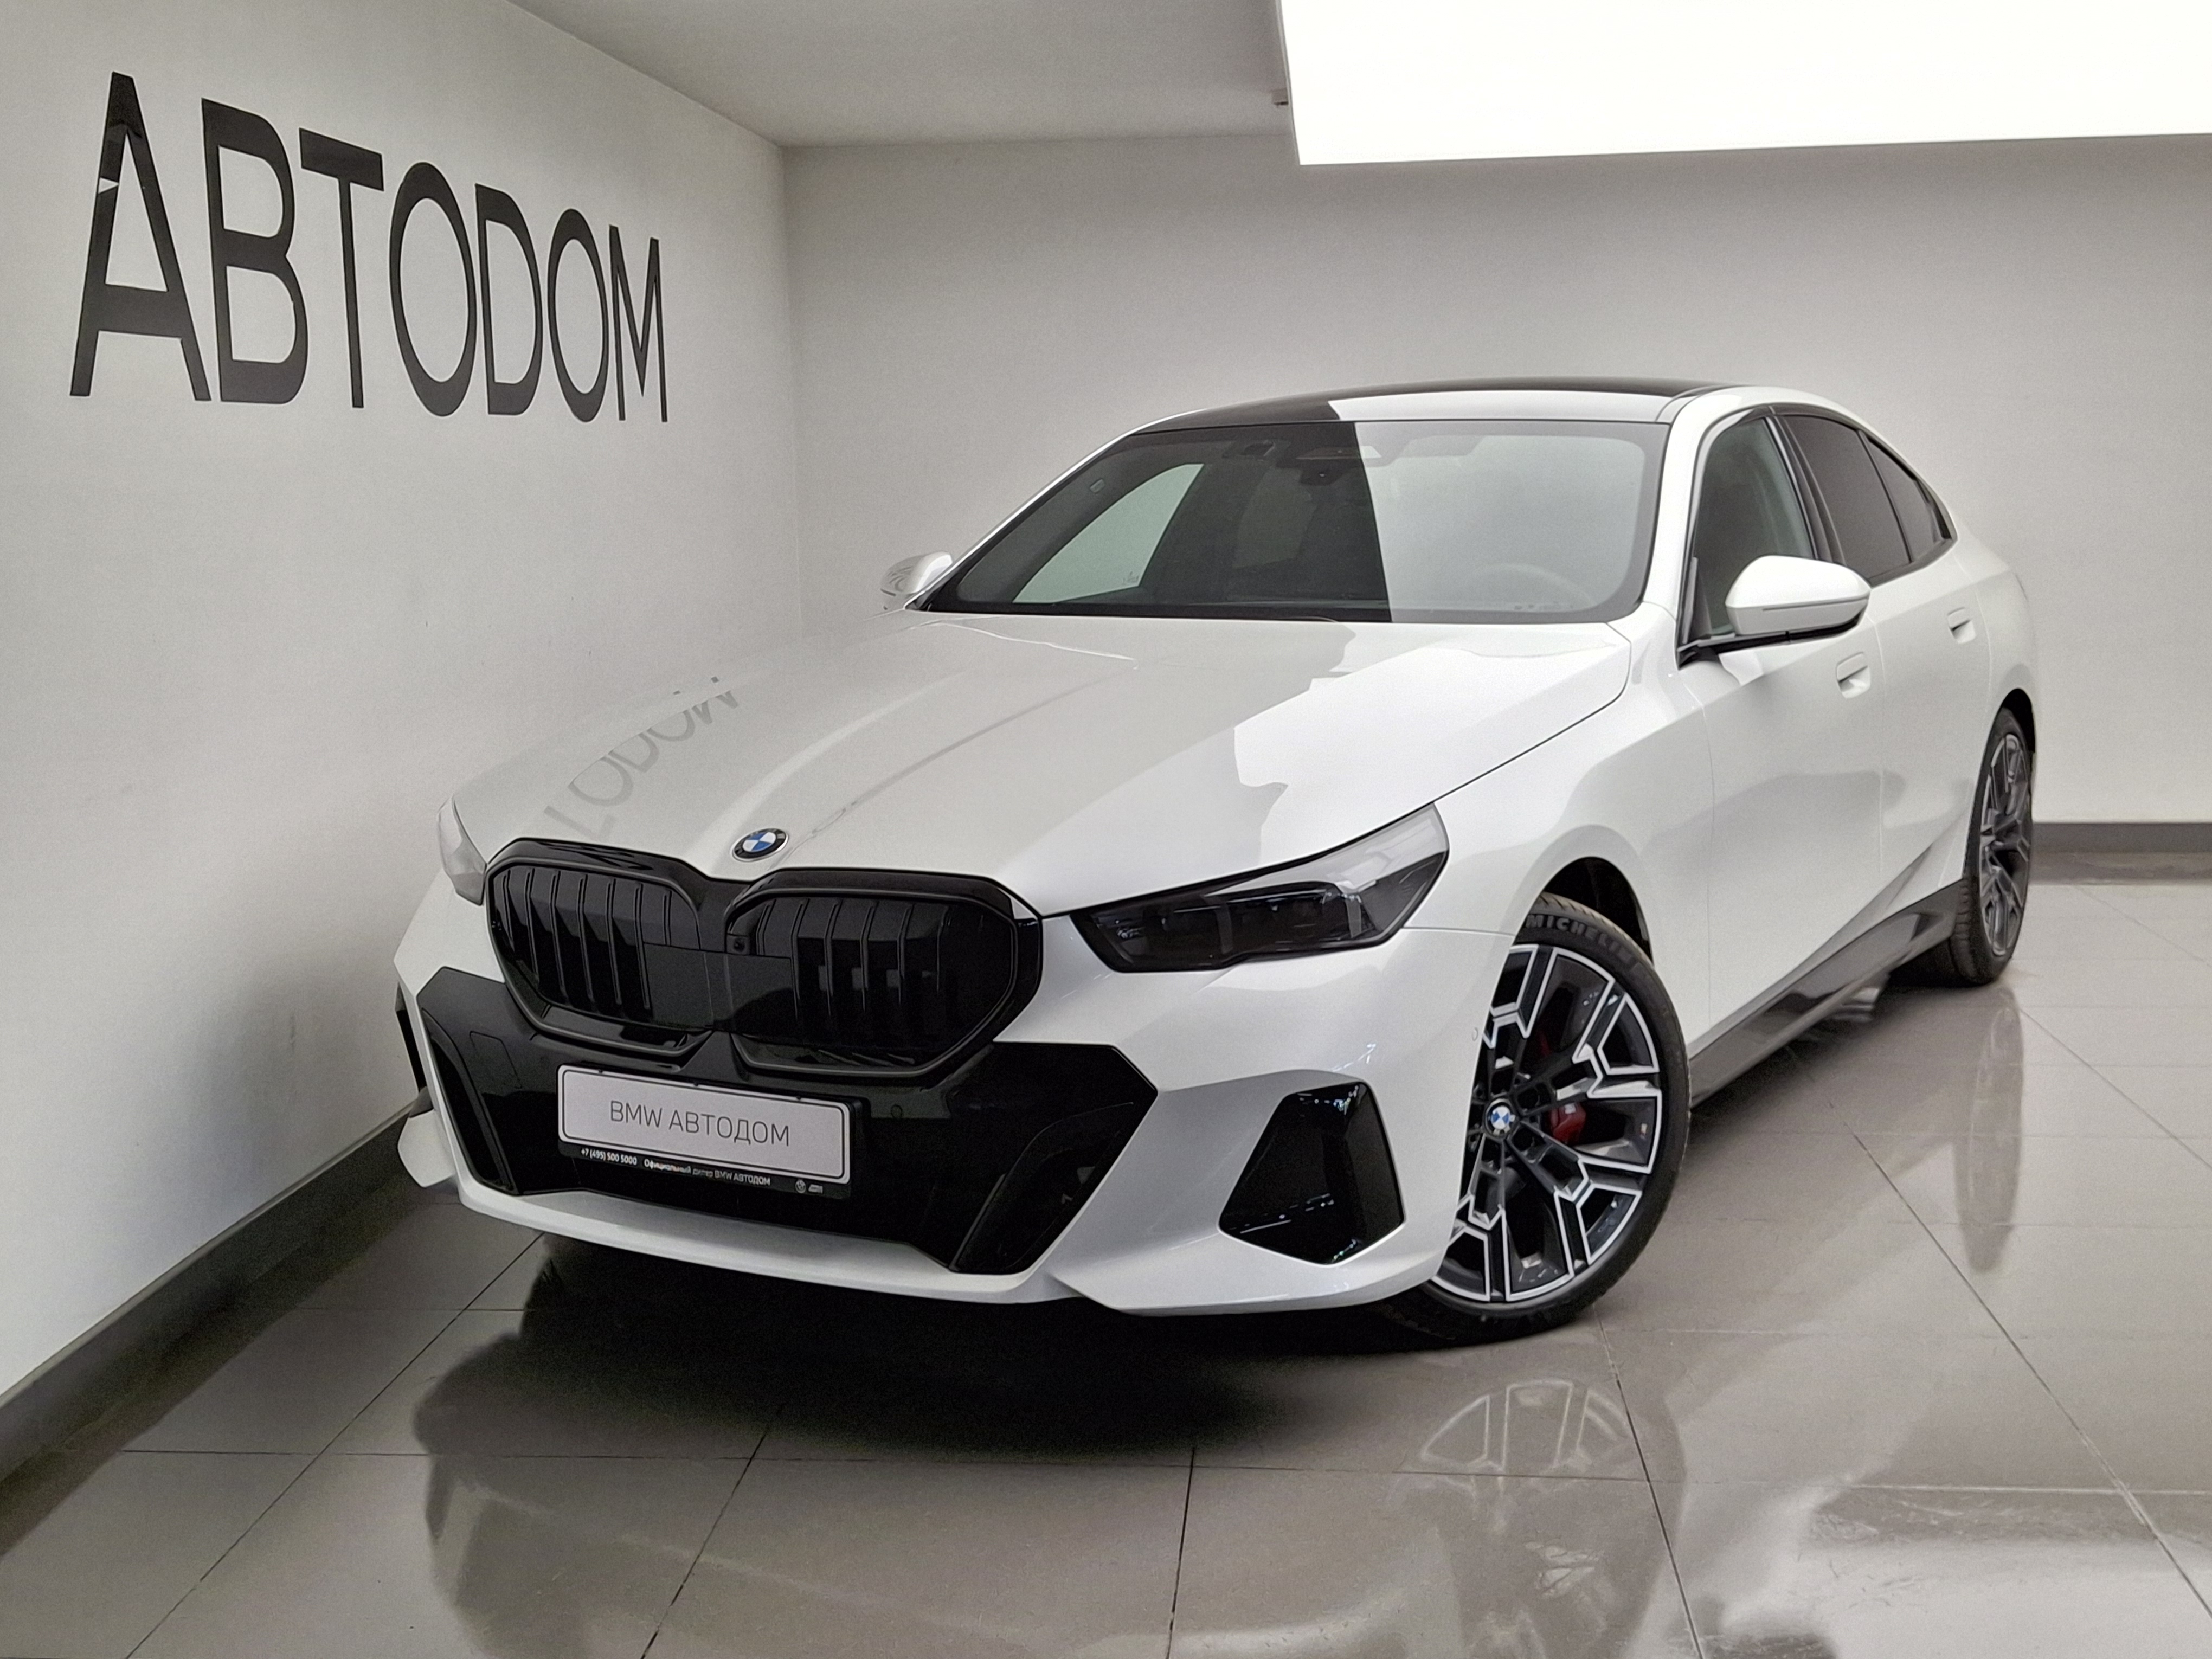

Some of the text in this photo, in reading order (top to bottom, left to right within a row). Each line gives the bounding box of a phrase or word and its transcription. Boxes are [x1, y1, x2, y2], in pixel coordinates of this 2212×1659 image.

[610, 1100, 789, 1147] BMW АВТОДОМ
[581, 1148, 589, 1156] +7
[590, 1149, 606, 1161] (495)
[607, 1152, 619, 1162] 500
[620, 1154, 638, 1166] 5000
[715, 1169, 732, 1180] BMW
[733, 1173, 770, 1186] АВТОДОМ
